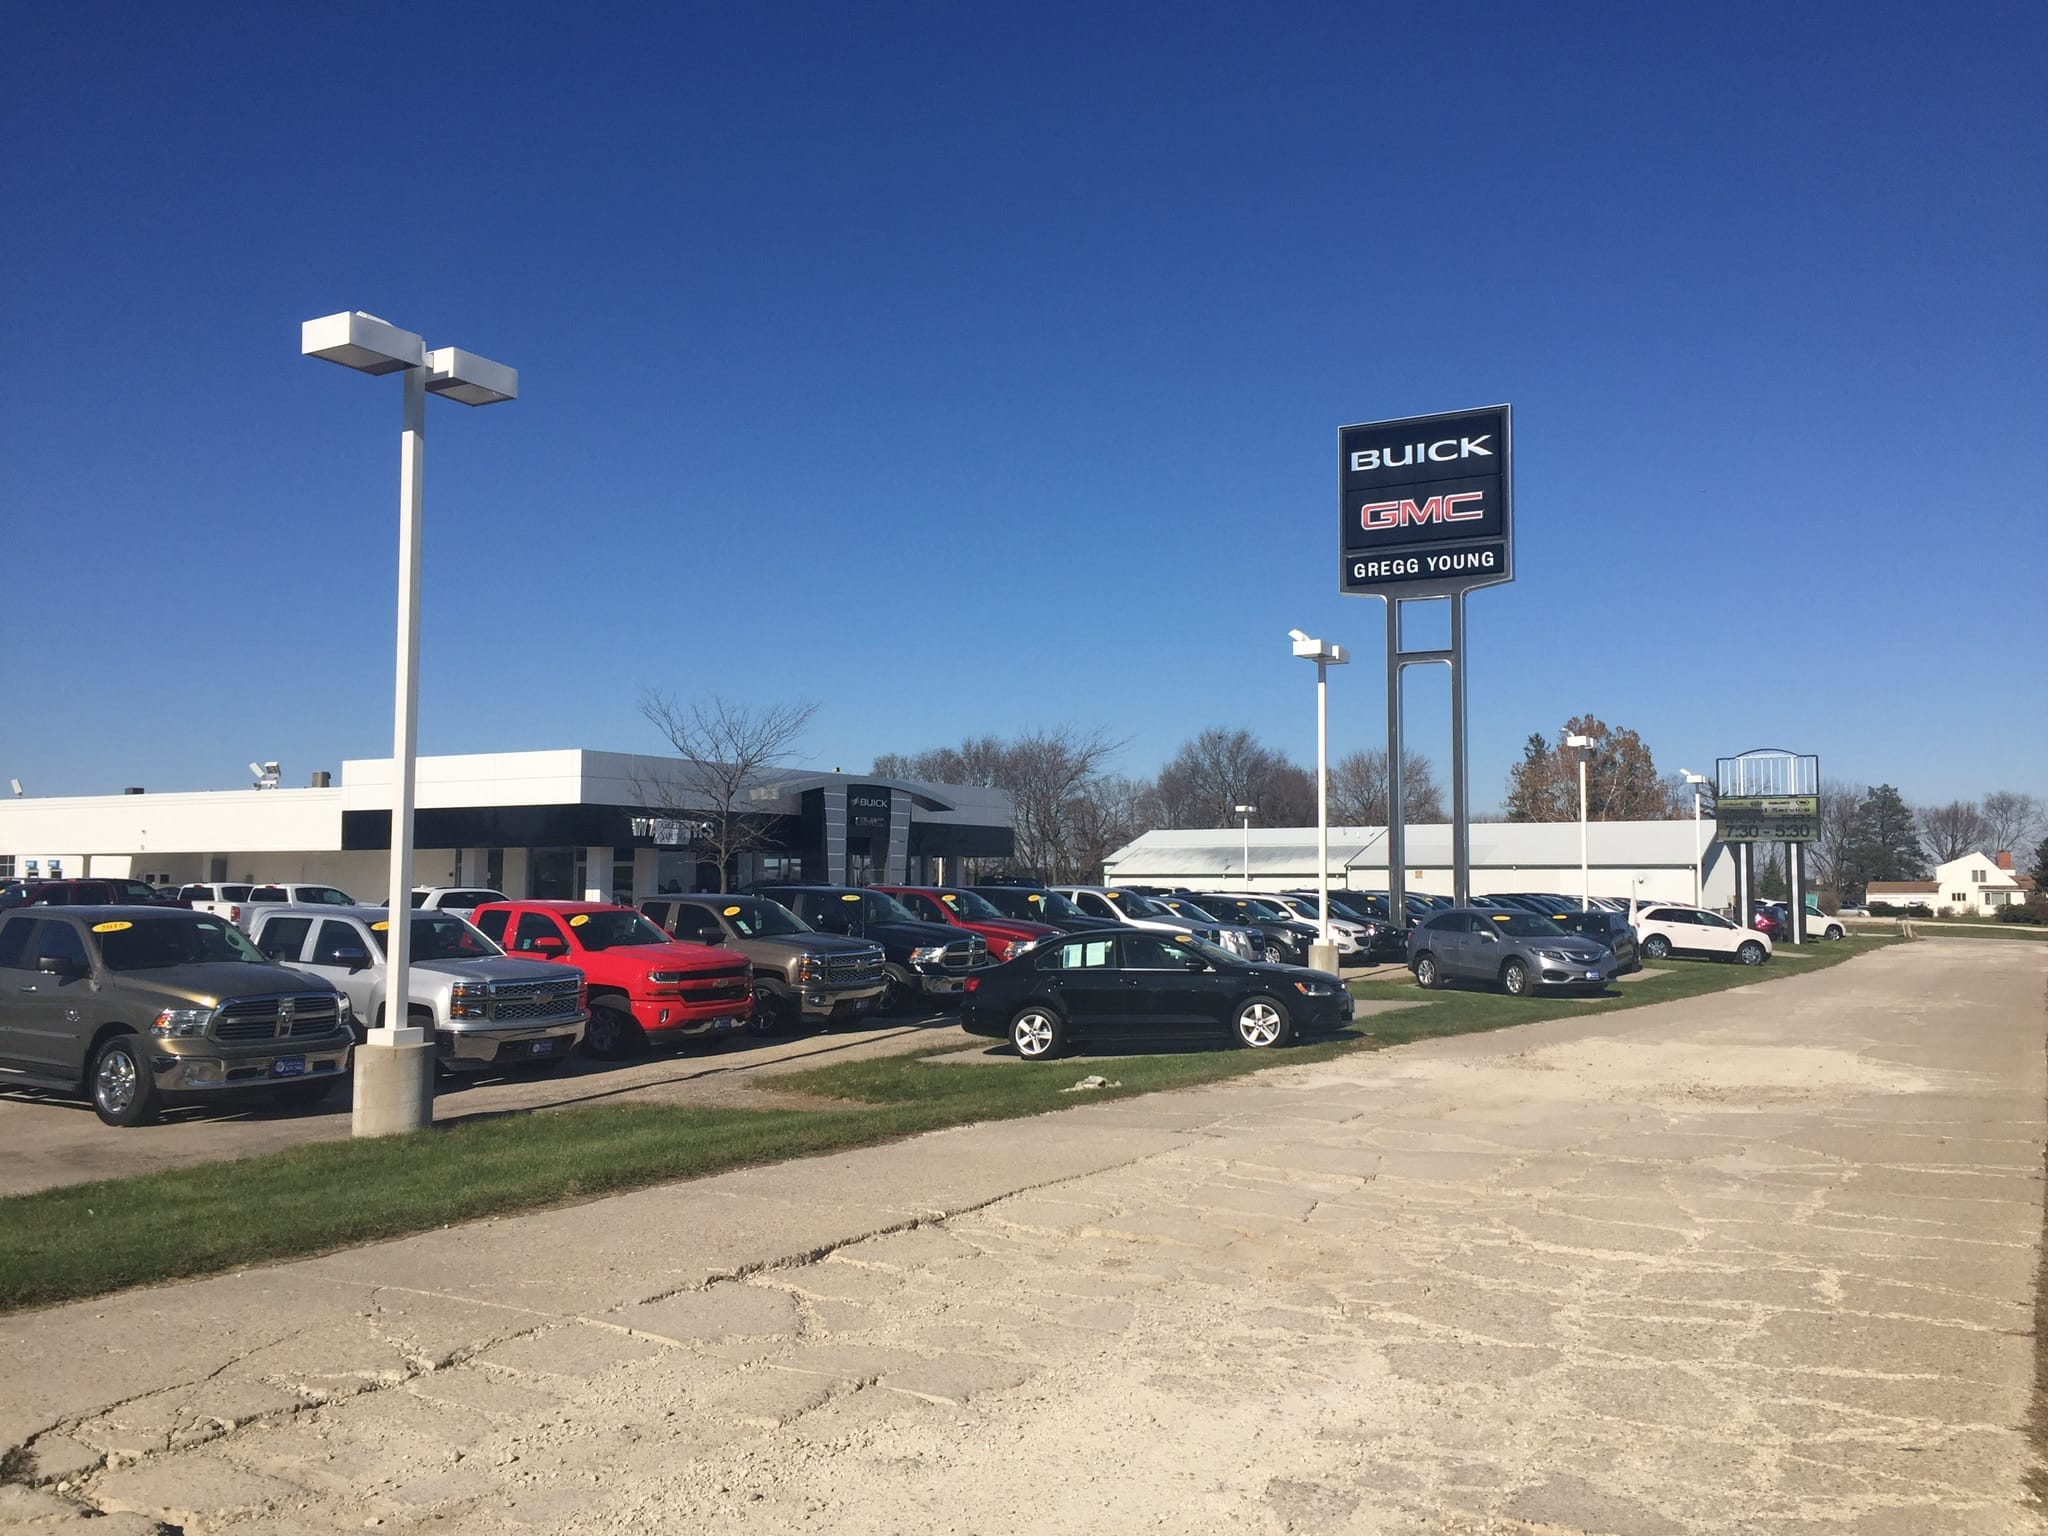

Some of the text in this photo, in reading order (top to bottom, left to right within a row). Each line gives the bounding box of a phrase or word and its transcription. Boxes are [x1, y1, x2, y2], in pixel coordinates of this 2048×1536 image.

[1351, 435, 1494, 472] BUICK
[1361, 491, 1484, 531] GMC
[1354, 551, 1495, 578] GREGG YOUNG
[860, 798, 888, 808] BUICK
[1725, 825, 1759, 838] 7:30
[1775, 824, 1810, 838] 5:30
